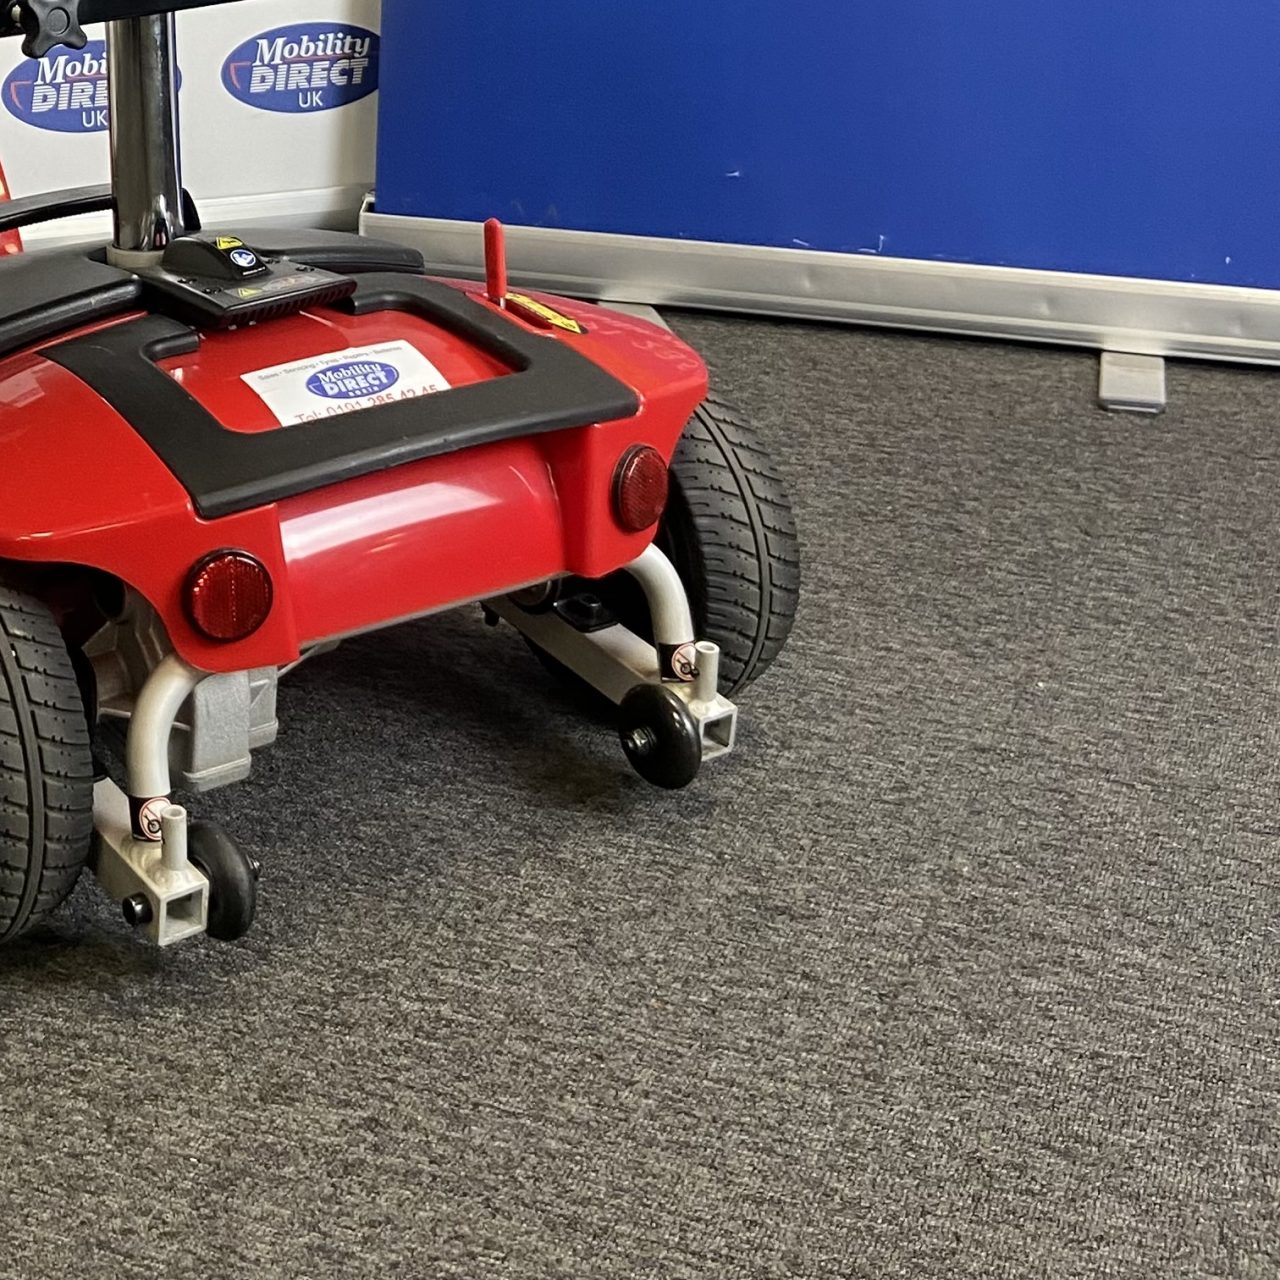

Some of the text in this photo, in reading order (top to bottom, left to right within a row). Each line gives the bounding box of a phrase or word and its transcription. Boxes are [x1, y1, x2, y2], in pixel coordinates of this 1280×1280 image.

[252, 32, 371, 66] Mobility
[34, 52, 108, 85] Mobi
[249, 58, 369, 93] DIRECT
[31, 80, 109, 112] DIRE
[298, 90, 324, 109] UK
[82, 109, 108, 128] UK
[316, 362, 382, 385] Mobility
[321, 371, 389, 396] DIRECT
